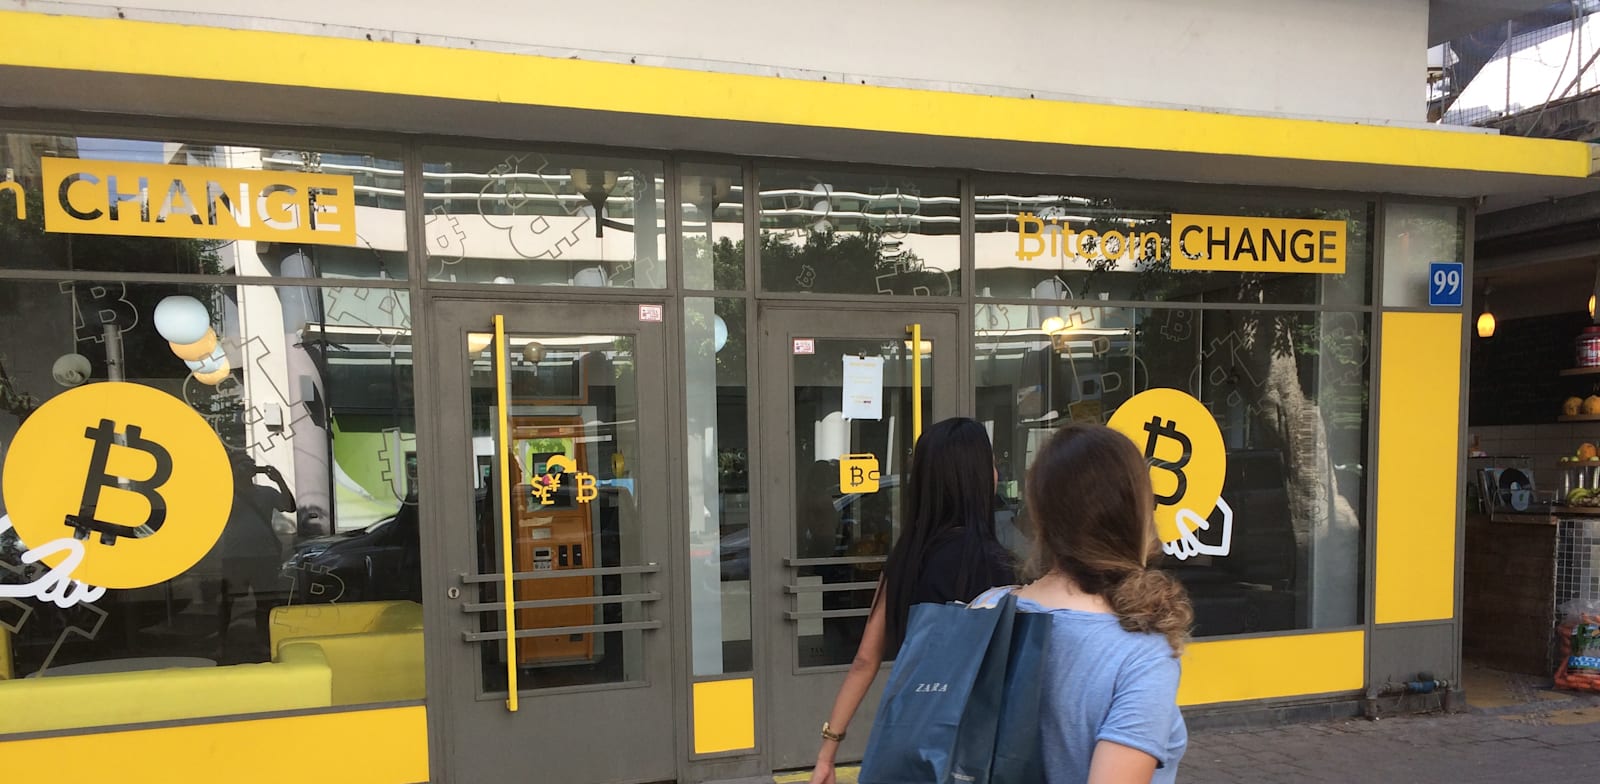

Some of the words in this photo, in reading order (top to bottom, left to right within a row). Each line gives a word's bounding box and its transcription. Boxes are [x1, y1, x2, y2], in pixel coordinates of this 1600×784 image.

[58, 172, 342, 232] CHANGE
[1015, 212, 1162, 261] Bitcoin
[1179, 224, 1337, 263] CHANGE
[1434, 270, 1460, 295] 99
[915, 682, 948, 693] ZARA
